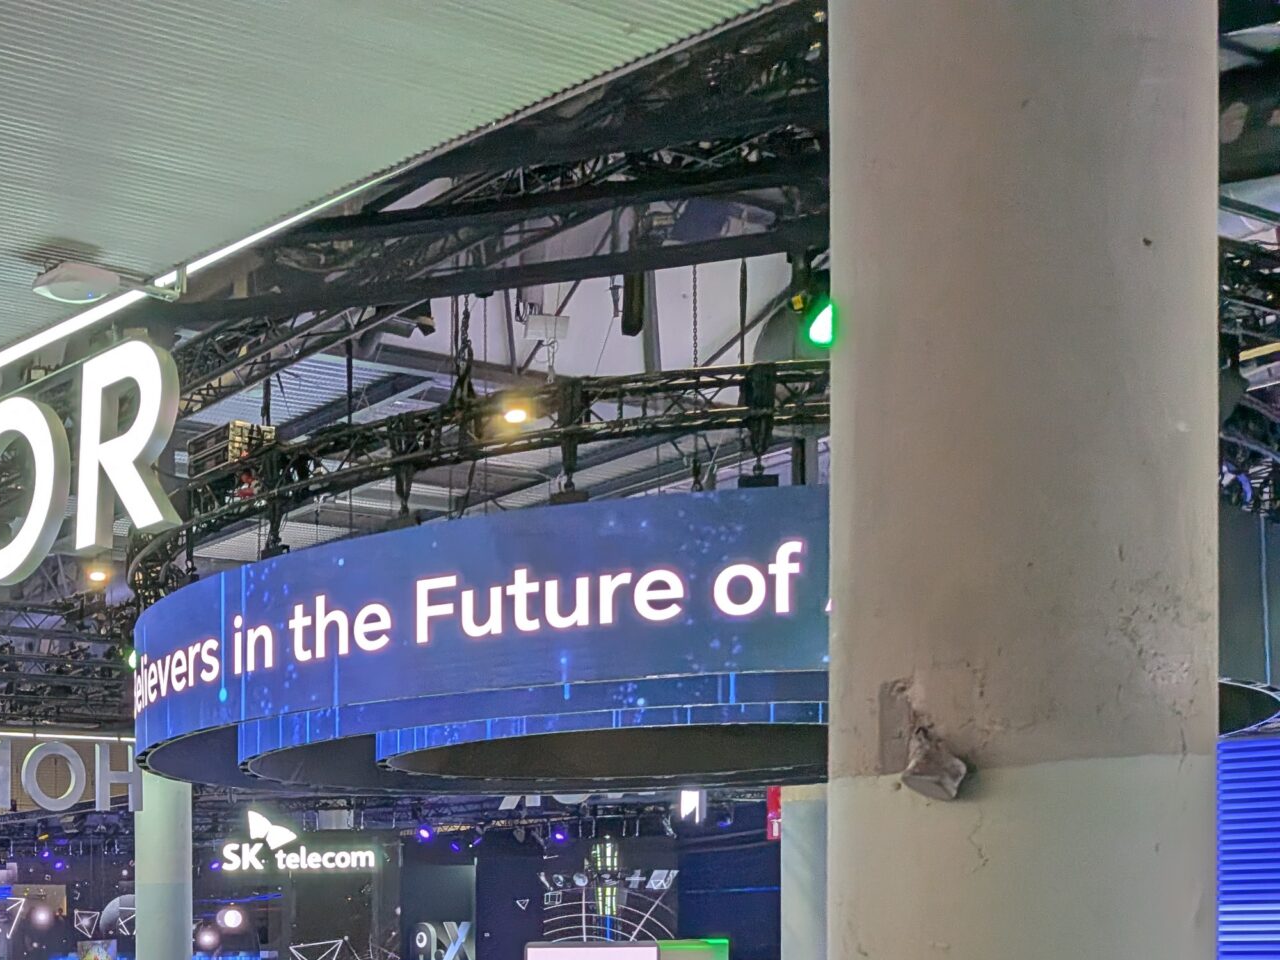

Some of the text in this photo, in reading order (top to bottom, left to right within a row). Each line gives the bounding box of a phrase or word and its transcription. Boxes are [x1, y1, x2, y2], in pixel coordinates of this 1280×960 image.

[134, 541, 802, 719] elievers in the Future of
[222, 843, 375, 870] SK telecom
